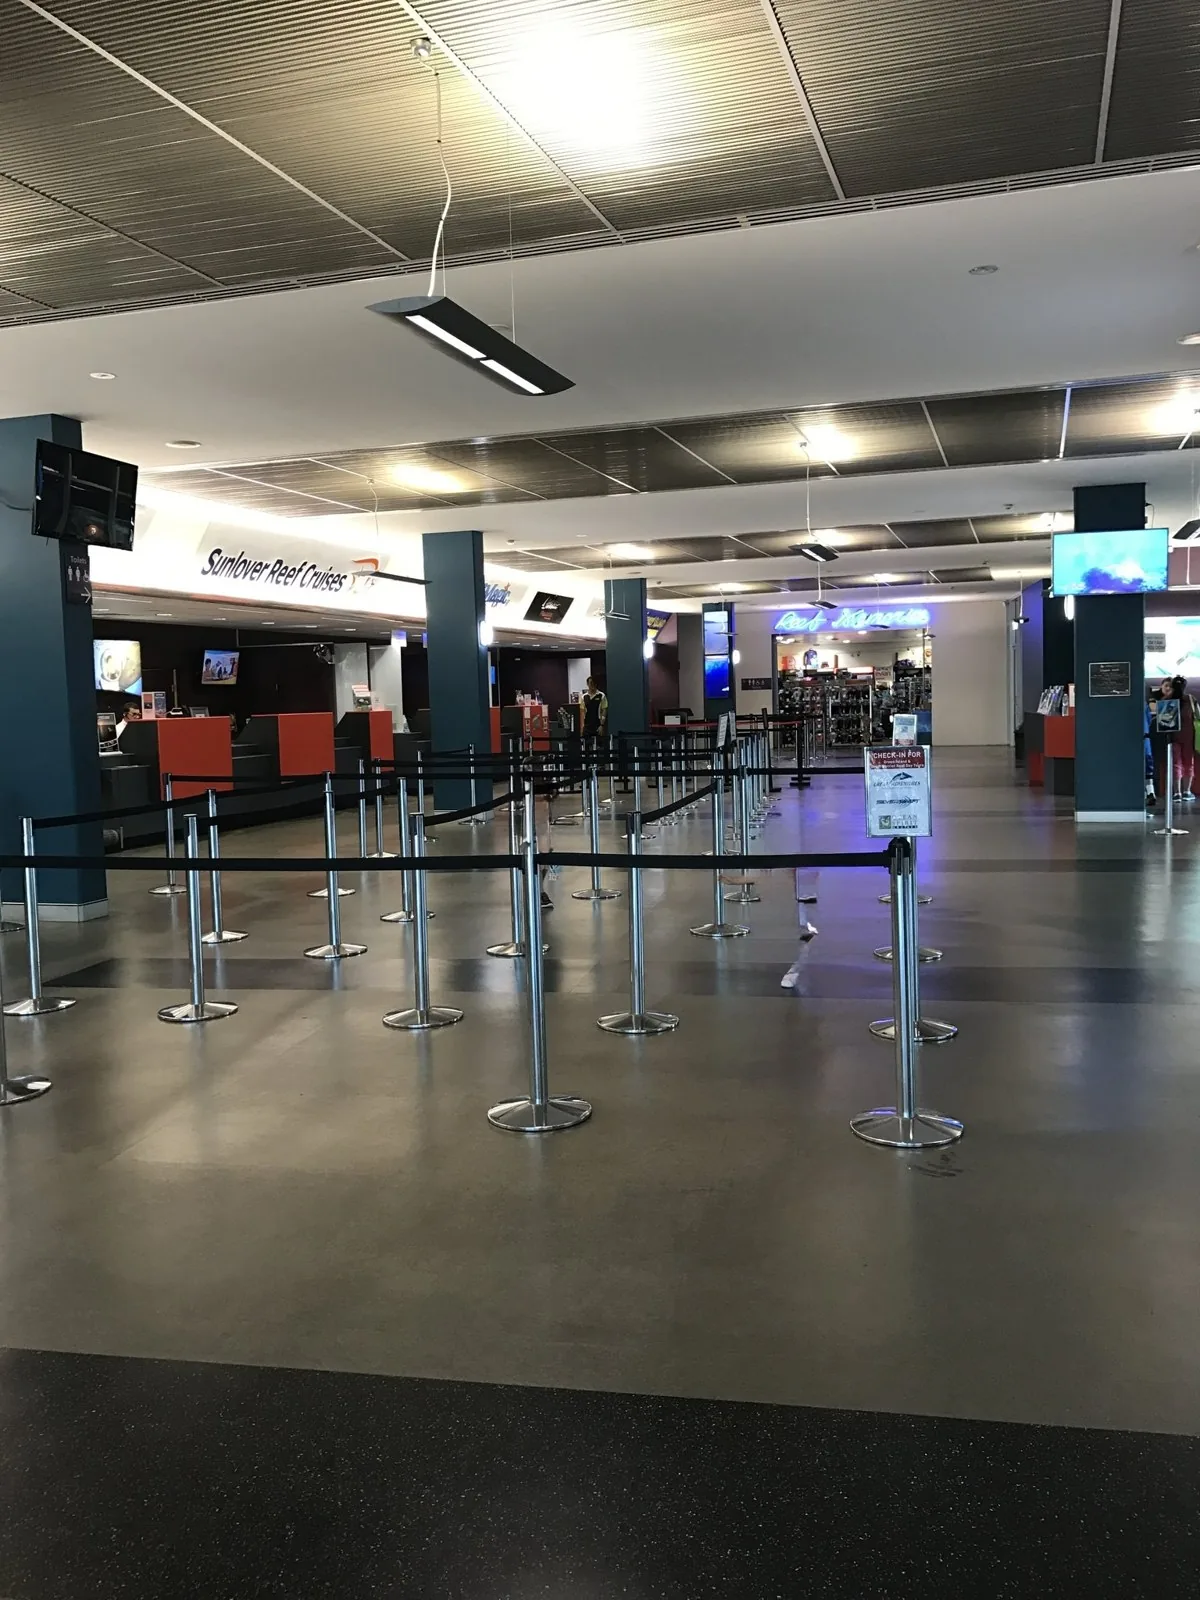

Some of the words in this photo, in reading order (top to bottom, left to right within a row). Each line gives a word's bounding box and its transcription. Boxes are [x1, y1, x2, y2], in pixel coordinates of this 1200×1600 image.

[201, 548, 271, 582] Sunlover
[265, 559, 308, 586] Reef
[300, 564, 348, 592] Cruises
[873, 751, 906, 759] CHECK-IN
[907, 750, 921, 758] FOR
